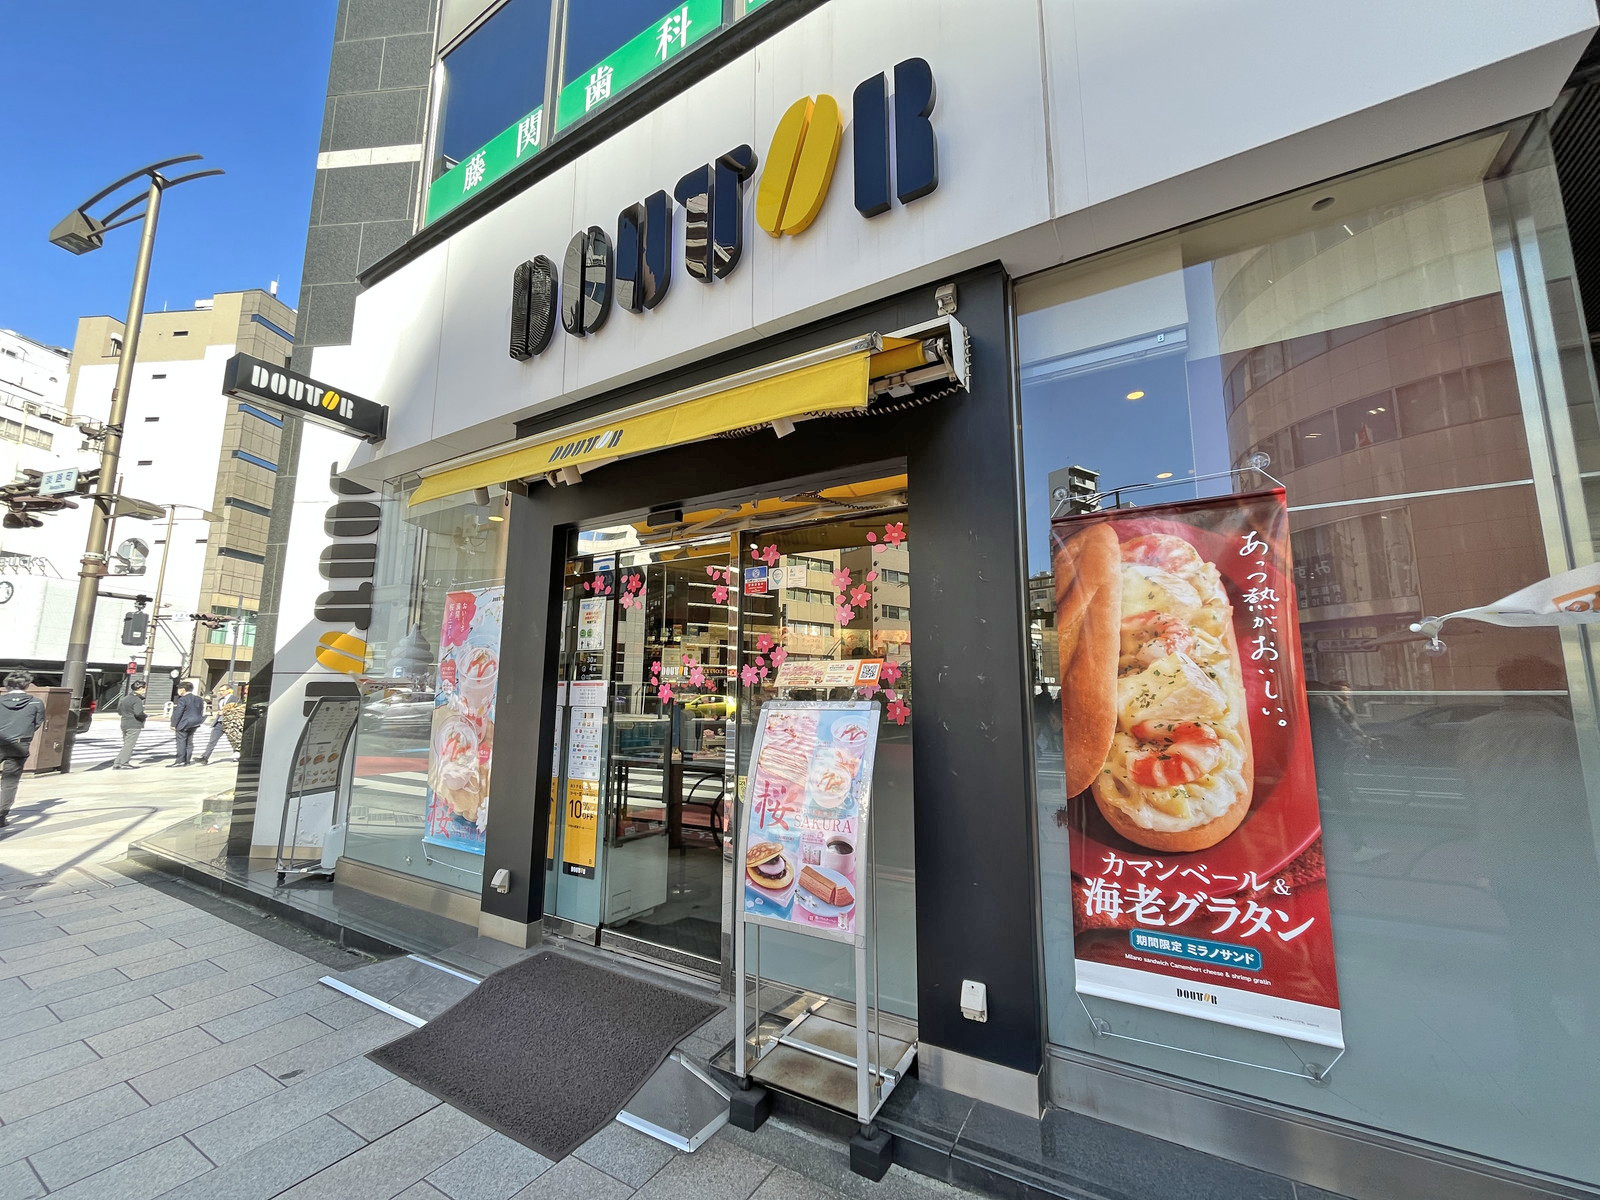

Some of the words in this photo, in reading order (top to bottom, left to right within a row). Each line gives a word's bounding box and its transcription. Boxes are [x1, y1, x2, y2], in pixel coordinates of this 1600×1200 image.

[509, 57, 939, 361] DOUTOR
[252, 365, 355, 420] DOUTOR
[548, 429, 624, 463] DOUTOR
[428, 792, 455, 839] 桜
[755, 780, 795, 829] 桜
[794, 814, 852, 833] SAKURA
[1101, 851, 1270, 892] カマンベール
[1273, 878, 1292, 896] &
[1082, 877, 1316, 942] 海老グラタン
[1124, 953, 1143, 962] Milano
[1143, 956, 1169, 967] sandwich
[1170, 961, 1202, 973] Camembert
[1203, 967, 1224, 977] cheese
[1231, 973, 1252, 983] shrimp
[1253, 977, 1272, 987] gratin
[1136, 934, 1183, 953] 期間限定
[1187, 943, 1255, 965] ミラノサンド
[1176, 988, 1218, 1005] DOUTOR
